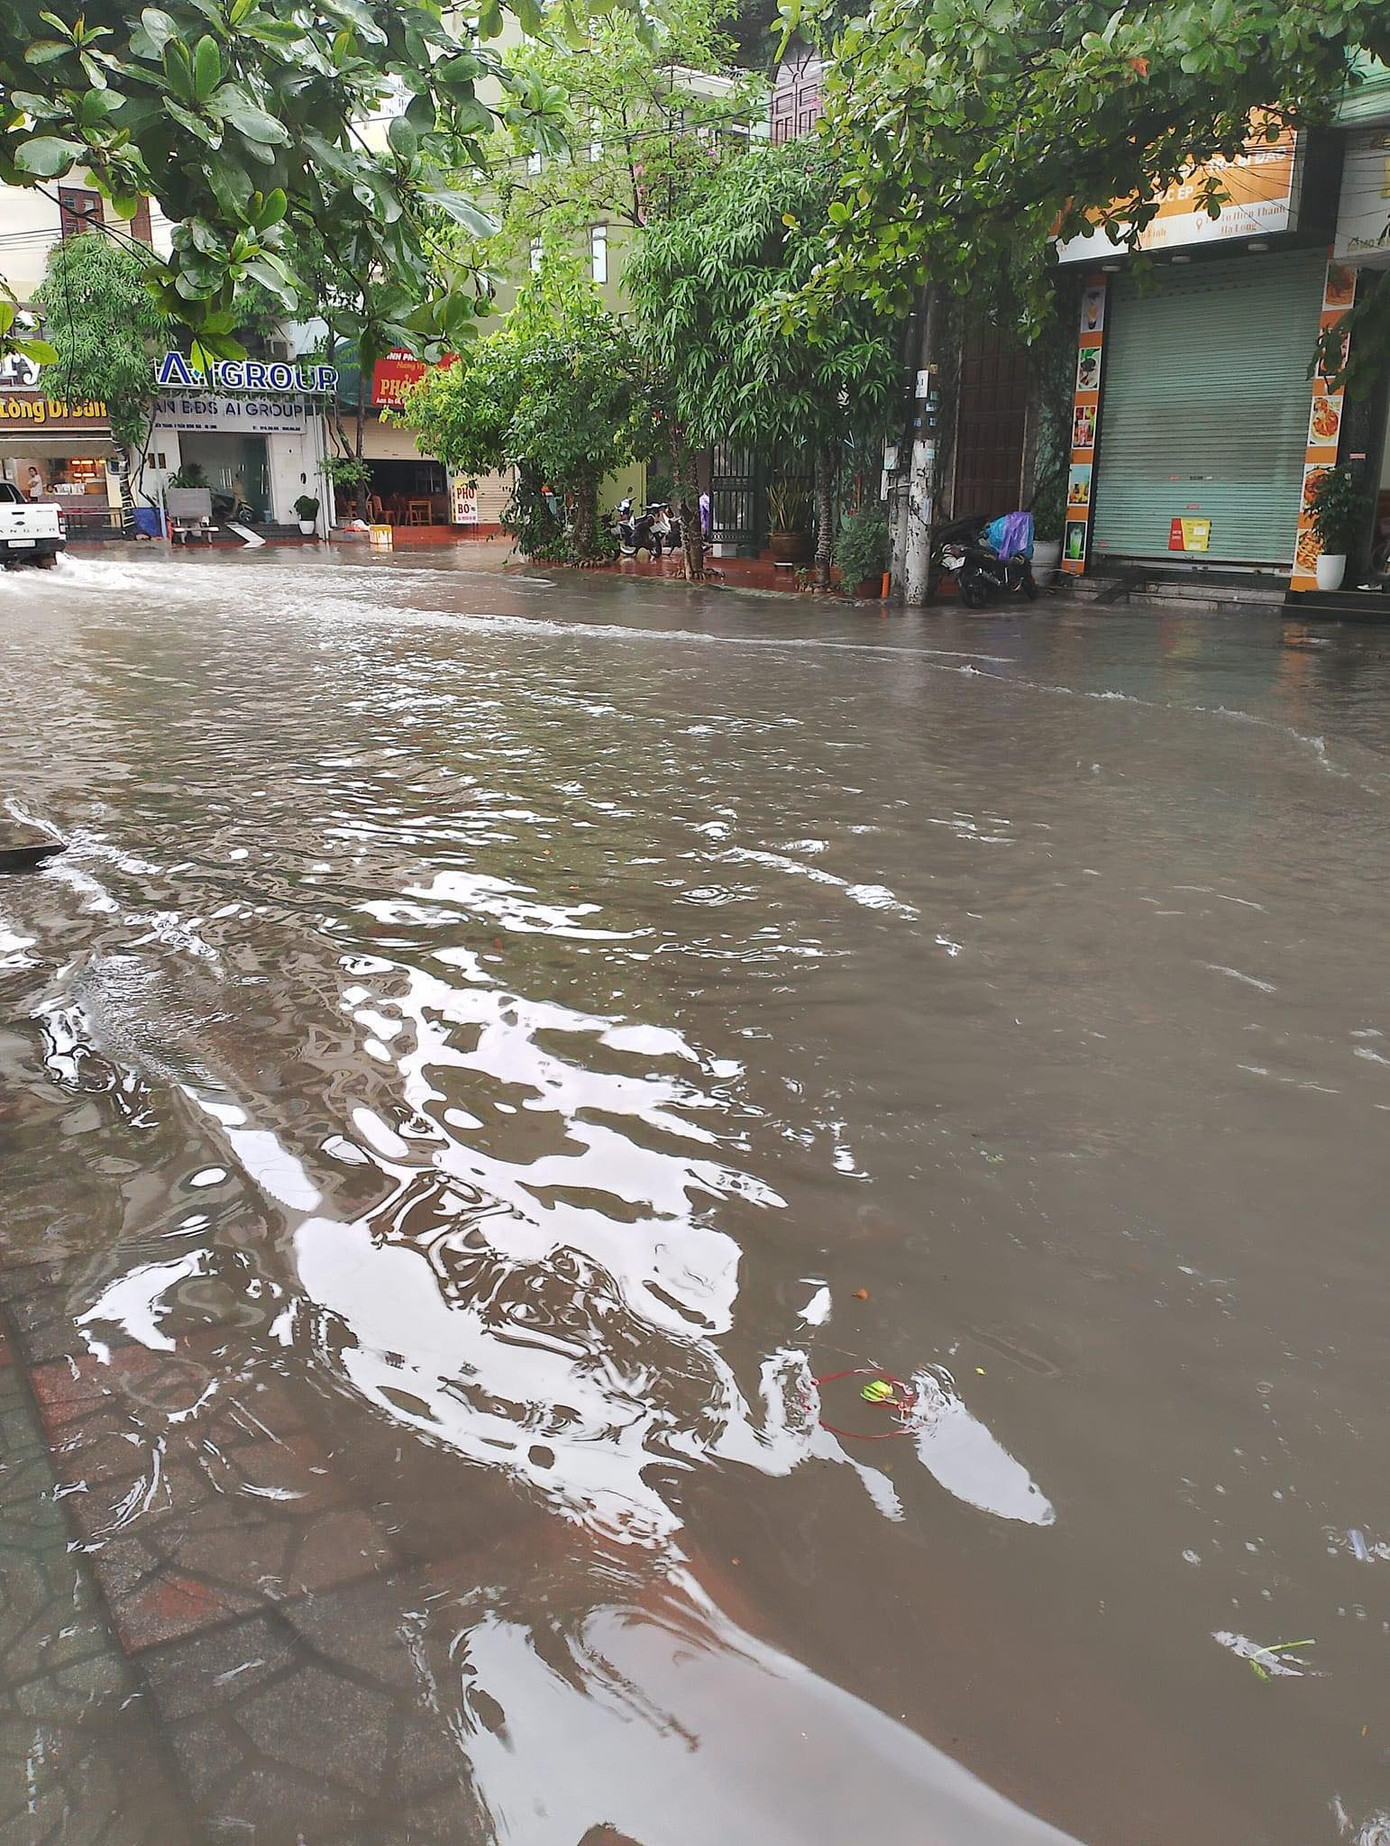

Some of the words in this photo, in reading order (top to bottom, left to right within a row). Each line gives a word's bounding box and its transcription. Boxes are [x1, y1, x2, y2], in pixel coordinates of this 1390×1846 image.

[0, 351, 41, 386] ry
[220, 360, 339, 393] GROUP
[225, 402, 241, 416] AI
[245, 402, 303, 418] GROUP
